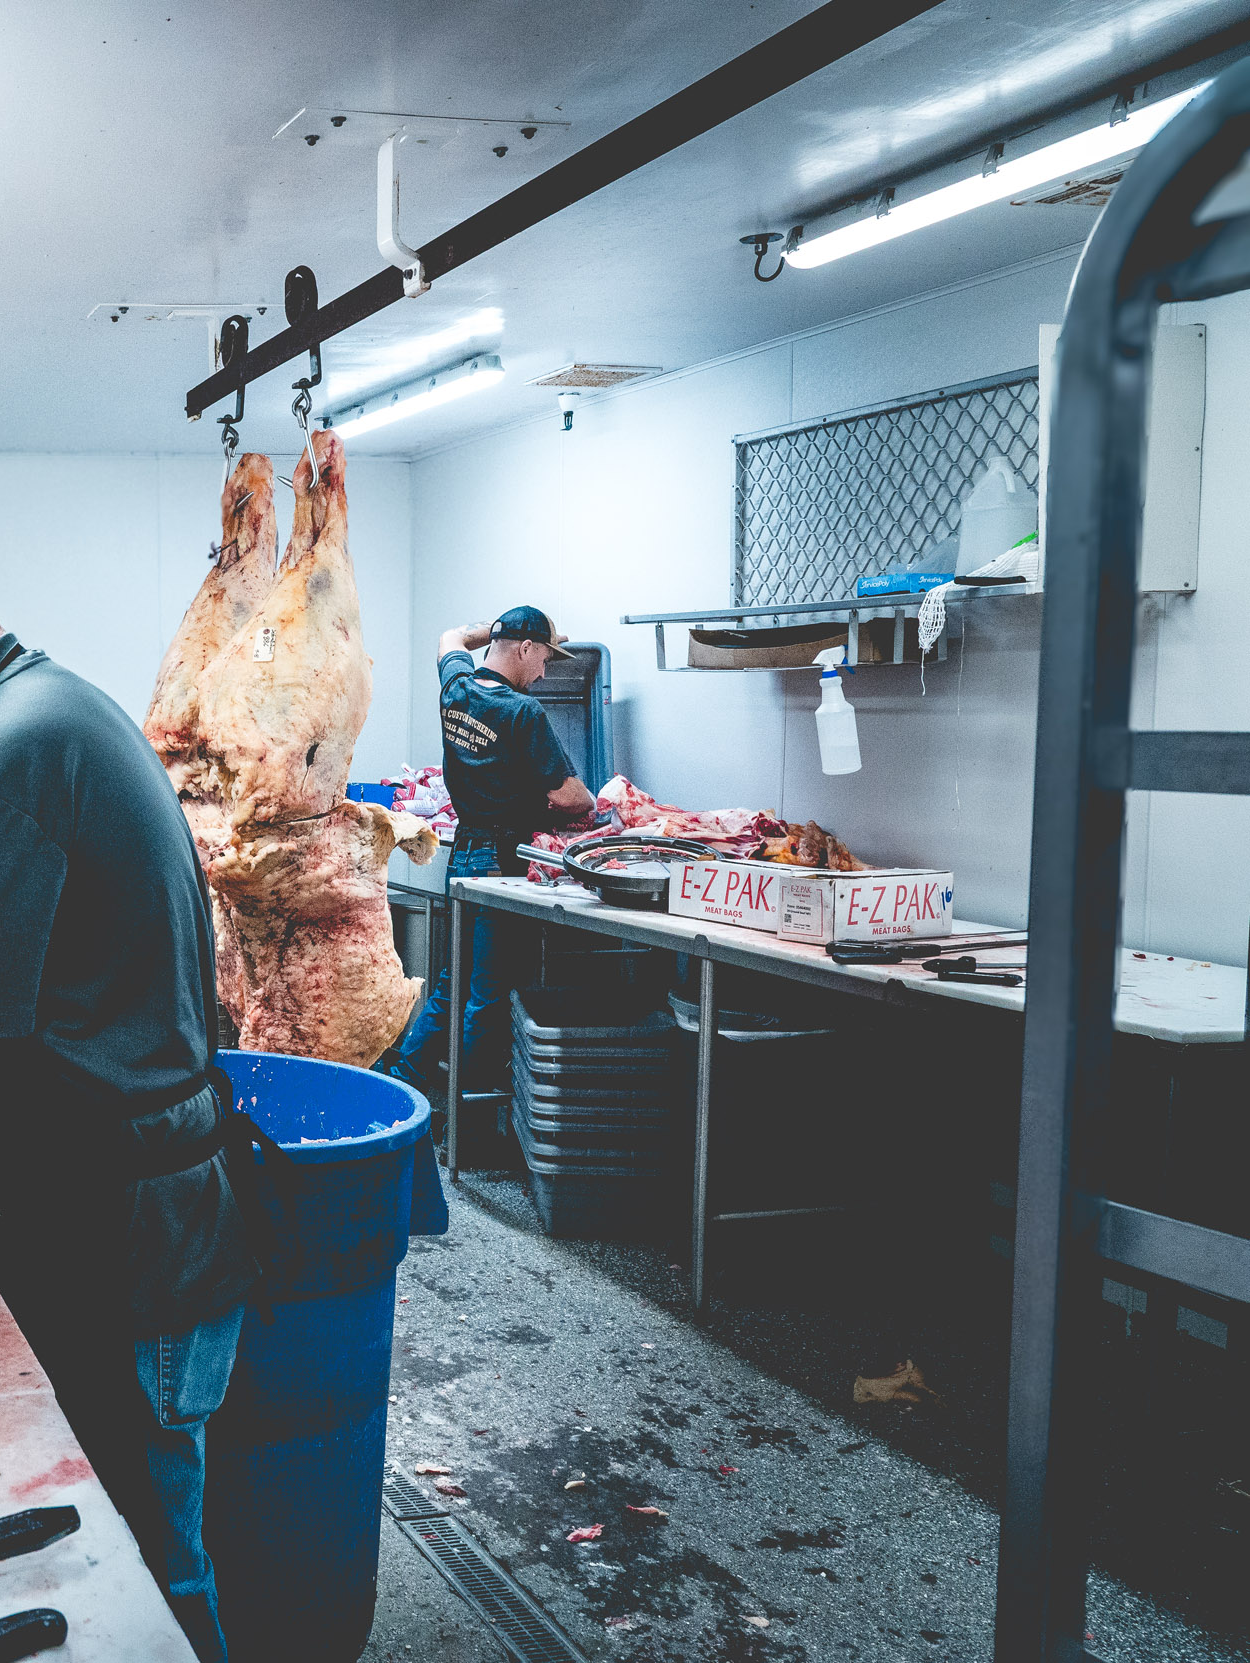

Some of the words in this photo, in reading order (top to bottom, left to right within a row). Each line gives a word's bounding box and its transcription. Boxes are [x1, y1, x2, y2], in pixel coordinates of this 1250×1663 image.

[475, 736, 488, 747] DELI
[681, 865, 719, 903] E-Z
[724, 870, 774, 912] PAK
[847, 886, 887, 926] E-Z
[893, 882, 938, 922] PAK
[705, 906, 722, 915] MEAT
[724, 909, 743, 918] BAGS
[872, 926, 891, 935] MEAT
[892, 925, 911, 934] BAGS
